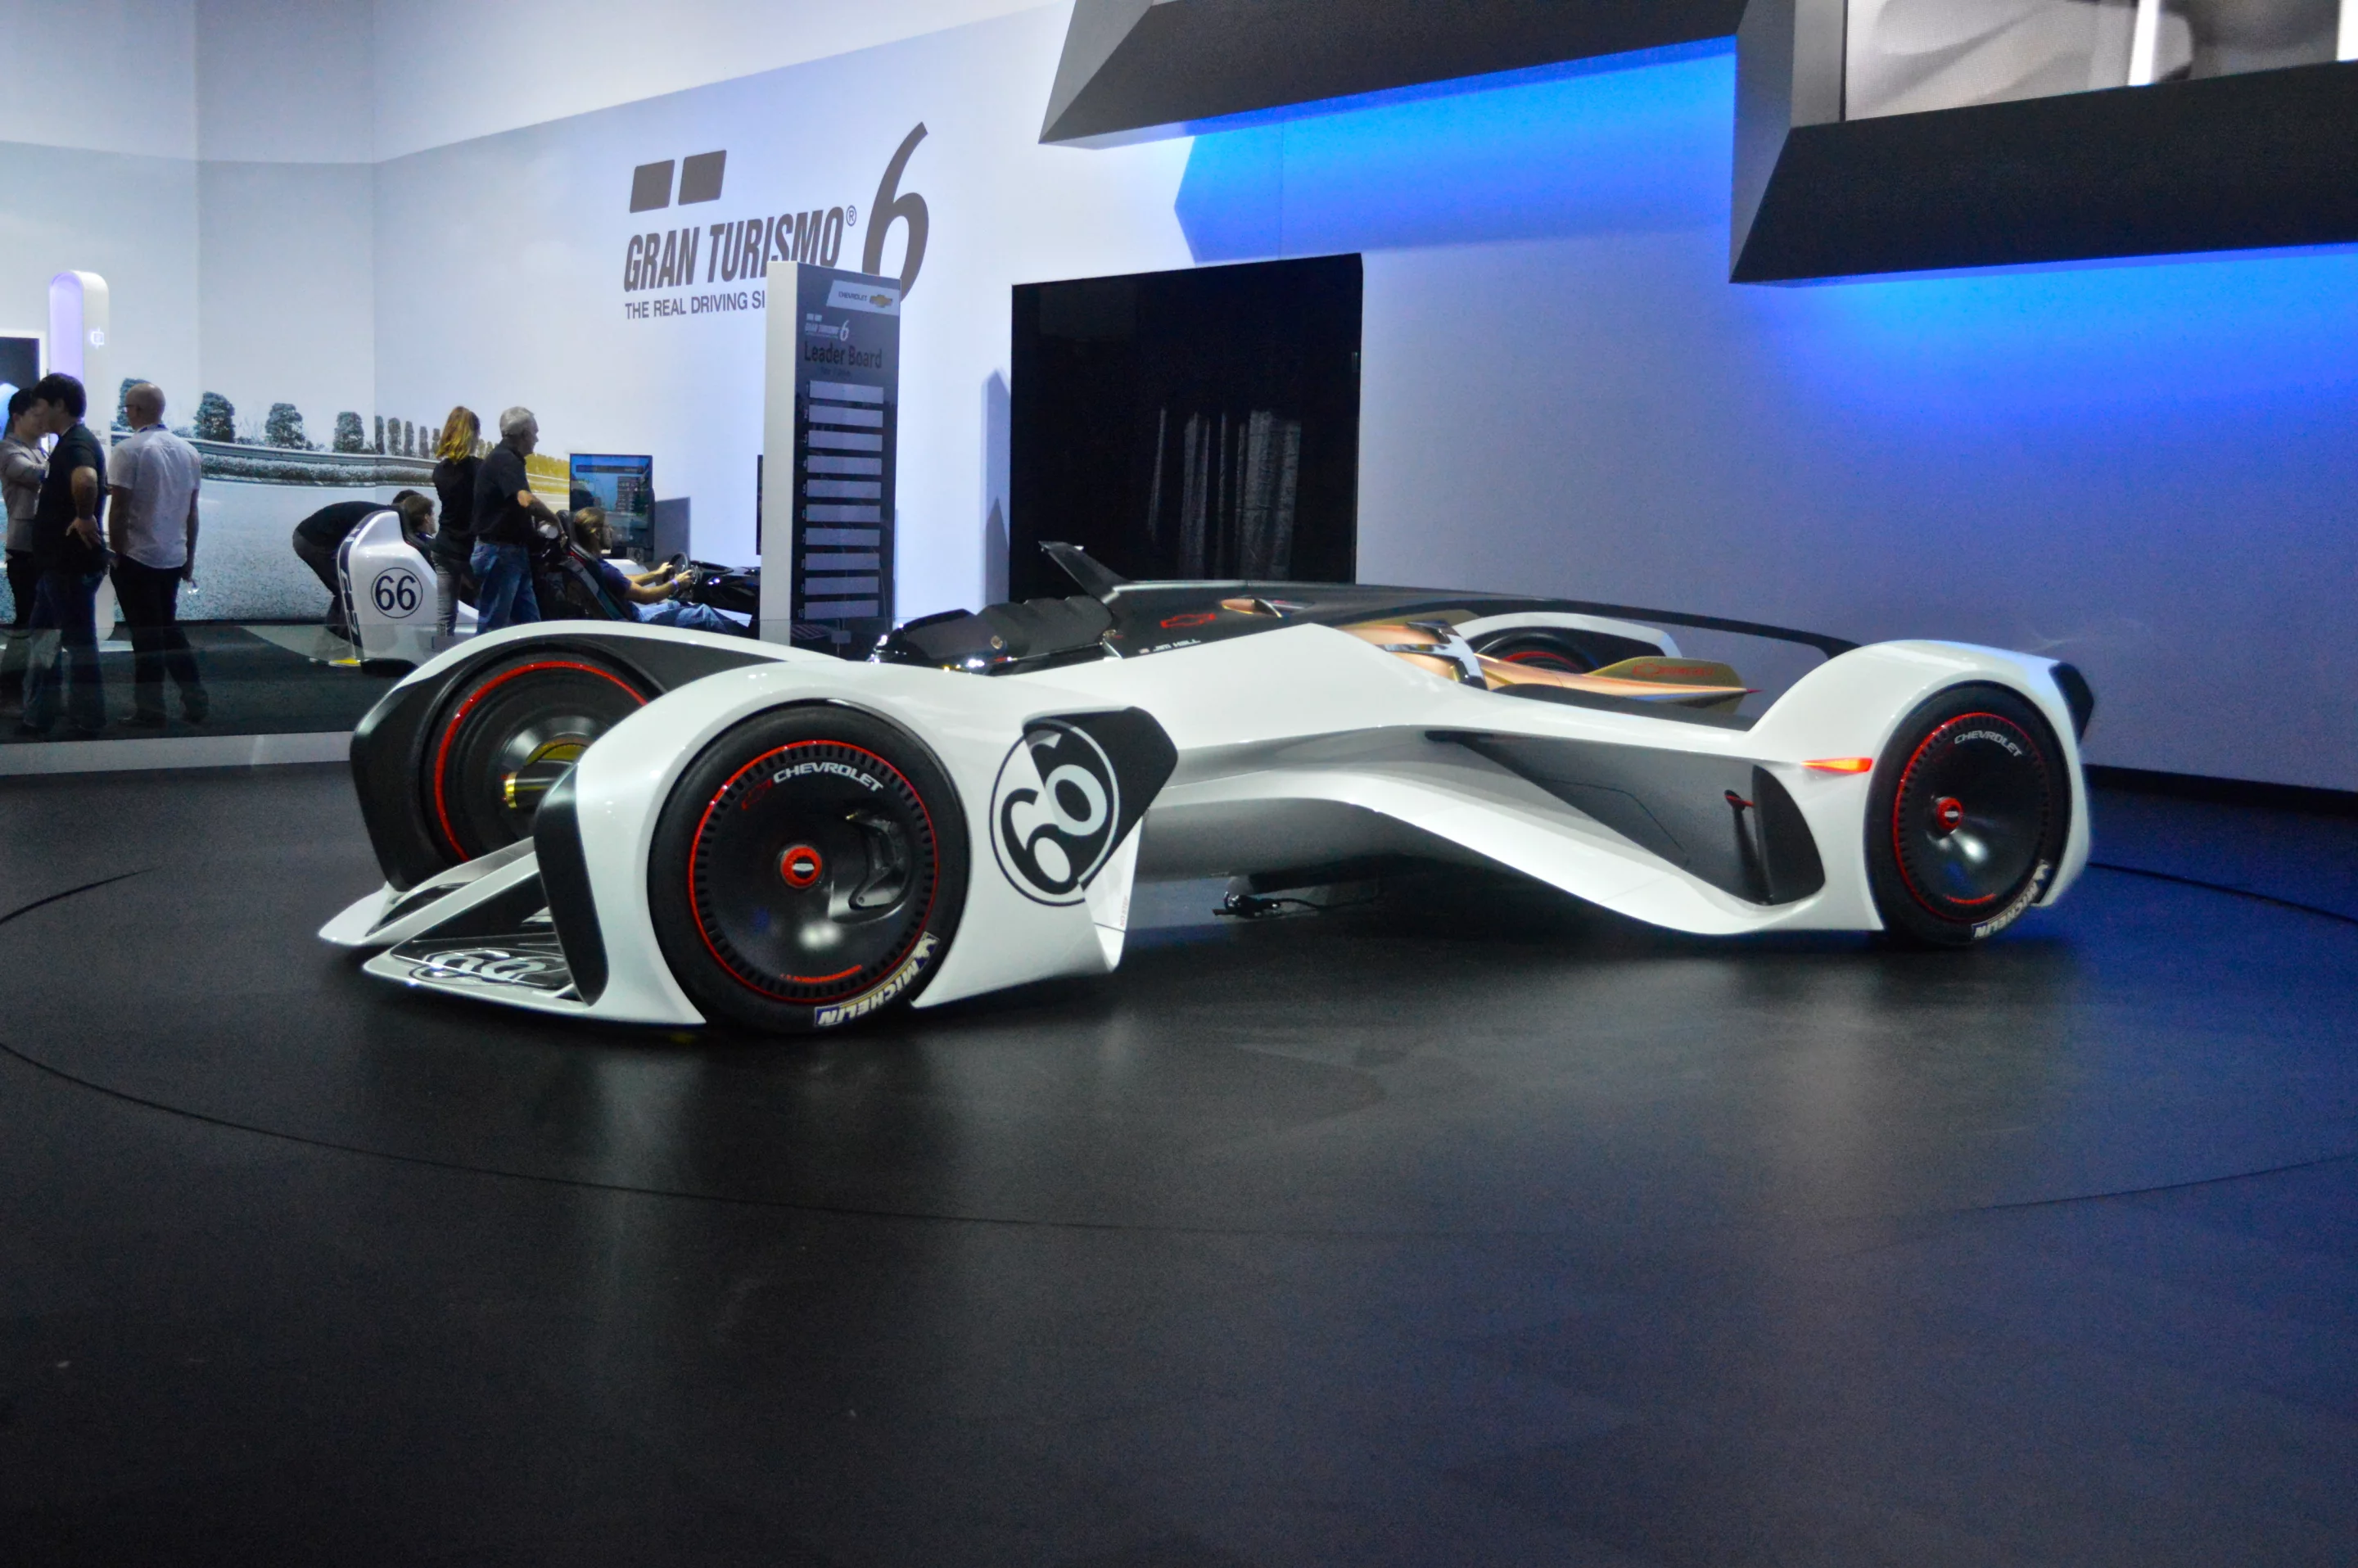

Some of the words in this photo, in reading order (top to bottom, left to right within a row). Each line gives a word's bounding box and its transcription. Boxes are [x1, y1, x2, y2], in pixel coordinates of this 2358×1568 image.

[624, 227, 699, 292] GRAN
[862, 121, 929, 302] 6
[625, 302, 649, 319] THE
[655, 296, 687, 317] REAL
[691, 291, 748, 313] DRIVING
[752, 290, 766, 309] SI
[804, 341, 845, 365] Leader
[848, 346, 883, 368] Board
[375, 575, 417, 611] 66
[1954, 730, 2022, 757] CHEVROLET
[773, 761, 884, 792] CHEVROLET
[1001, 732, 1108, 896] 66
[817, 960, 919, 1025] MICHELIN
